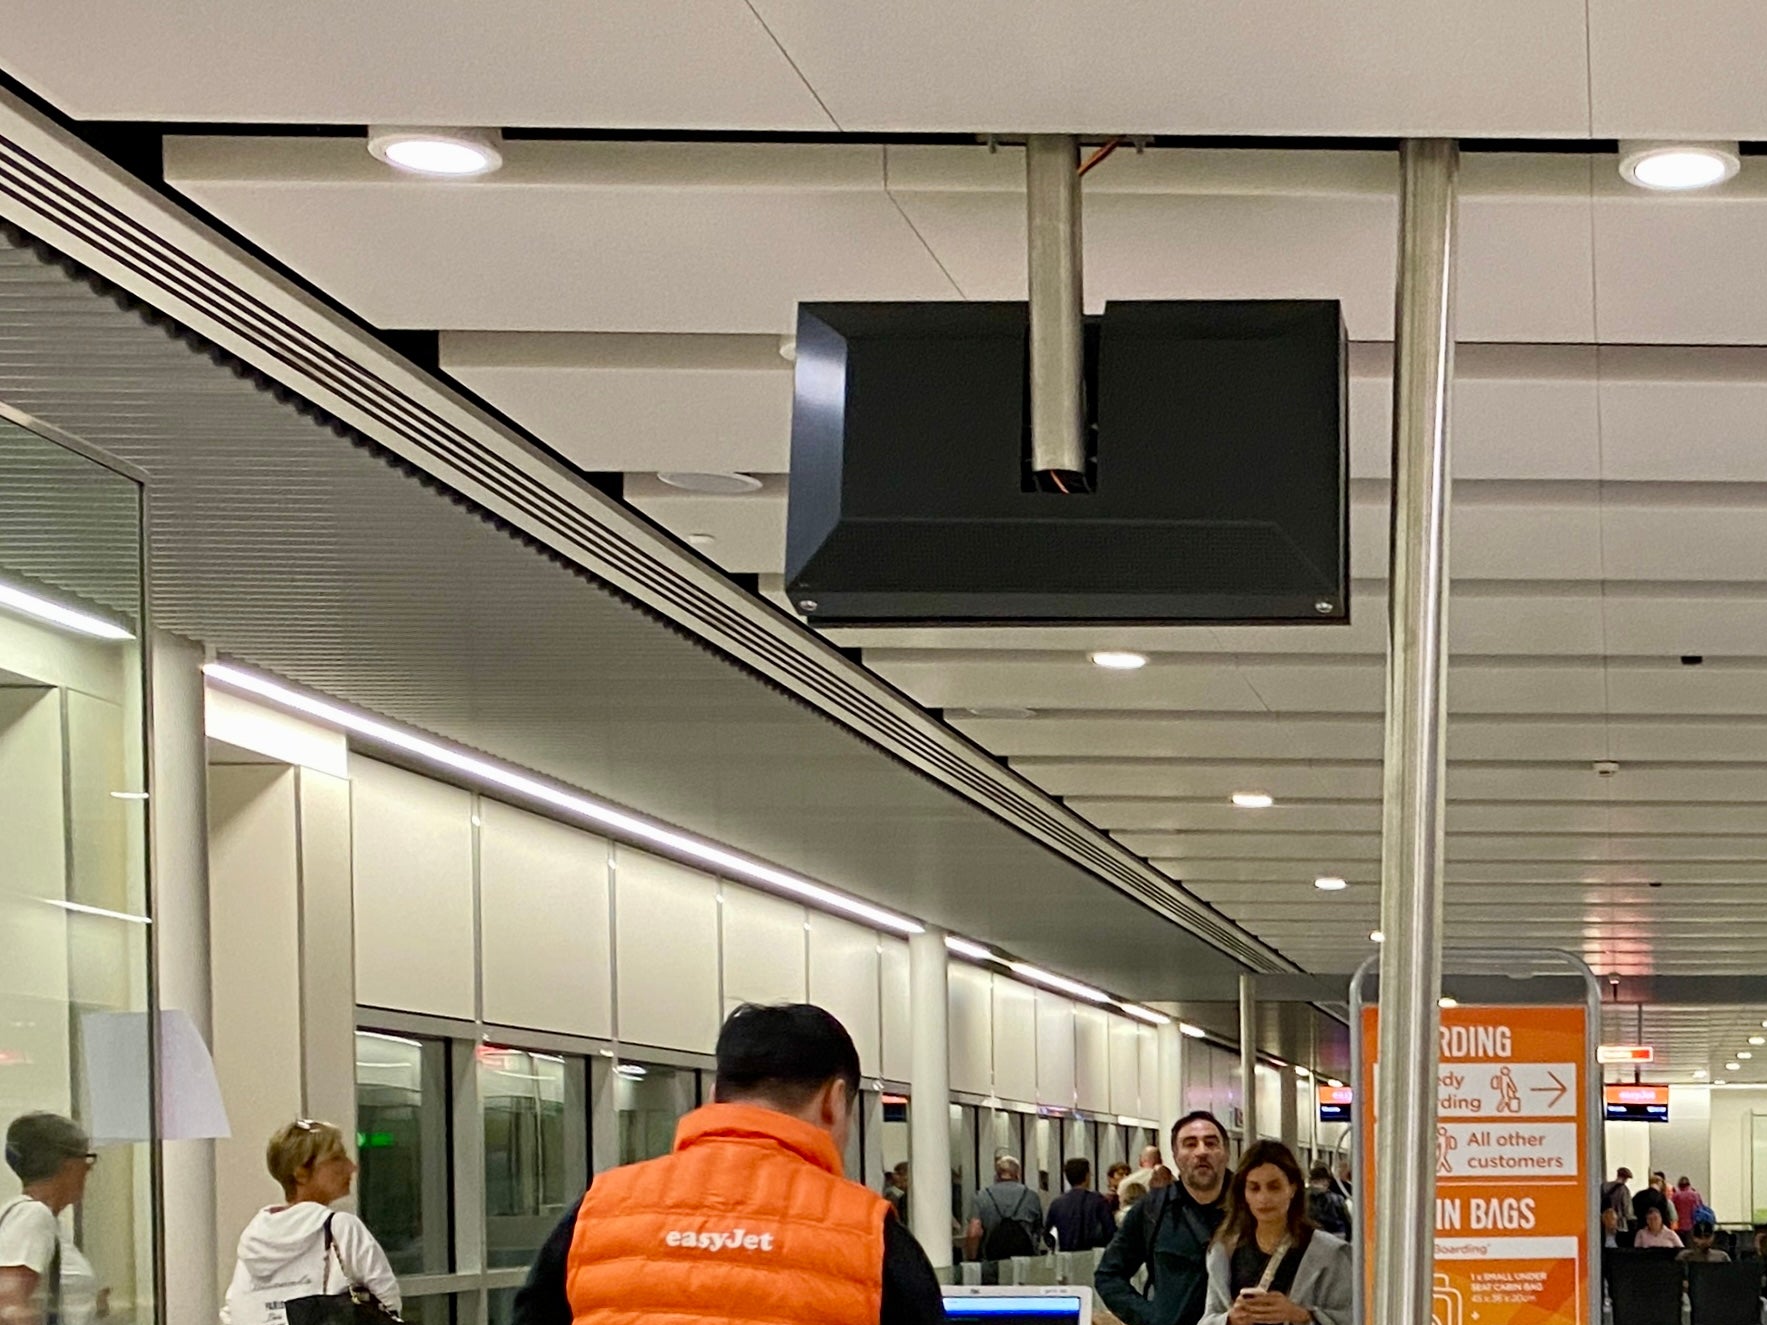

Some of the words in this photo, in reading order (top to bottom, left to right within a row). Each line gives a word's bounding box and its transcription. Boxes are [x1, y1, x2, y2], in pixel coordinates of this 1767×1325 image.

[1438, 1094, 1481, 1112] ding
[1467, 1132, 1490, 1147] All
[1496, 1132, 1546, 1147] other
[1467, 1155, 1564, 1168] customers
[1470, 1197, 1536, 1230] BAGS
[665, 1228, 775, 1252] easyJet
